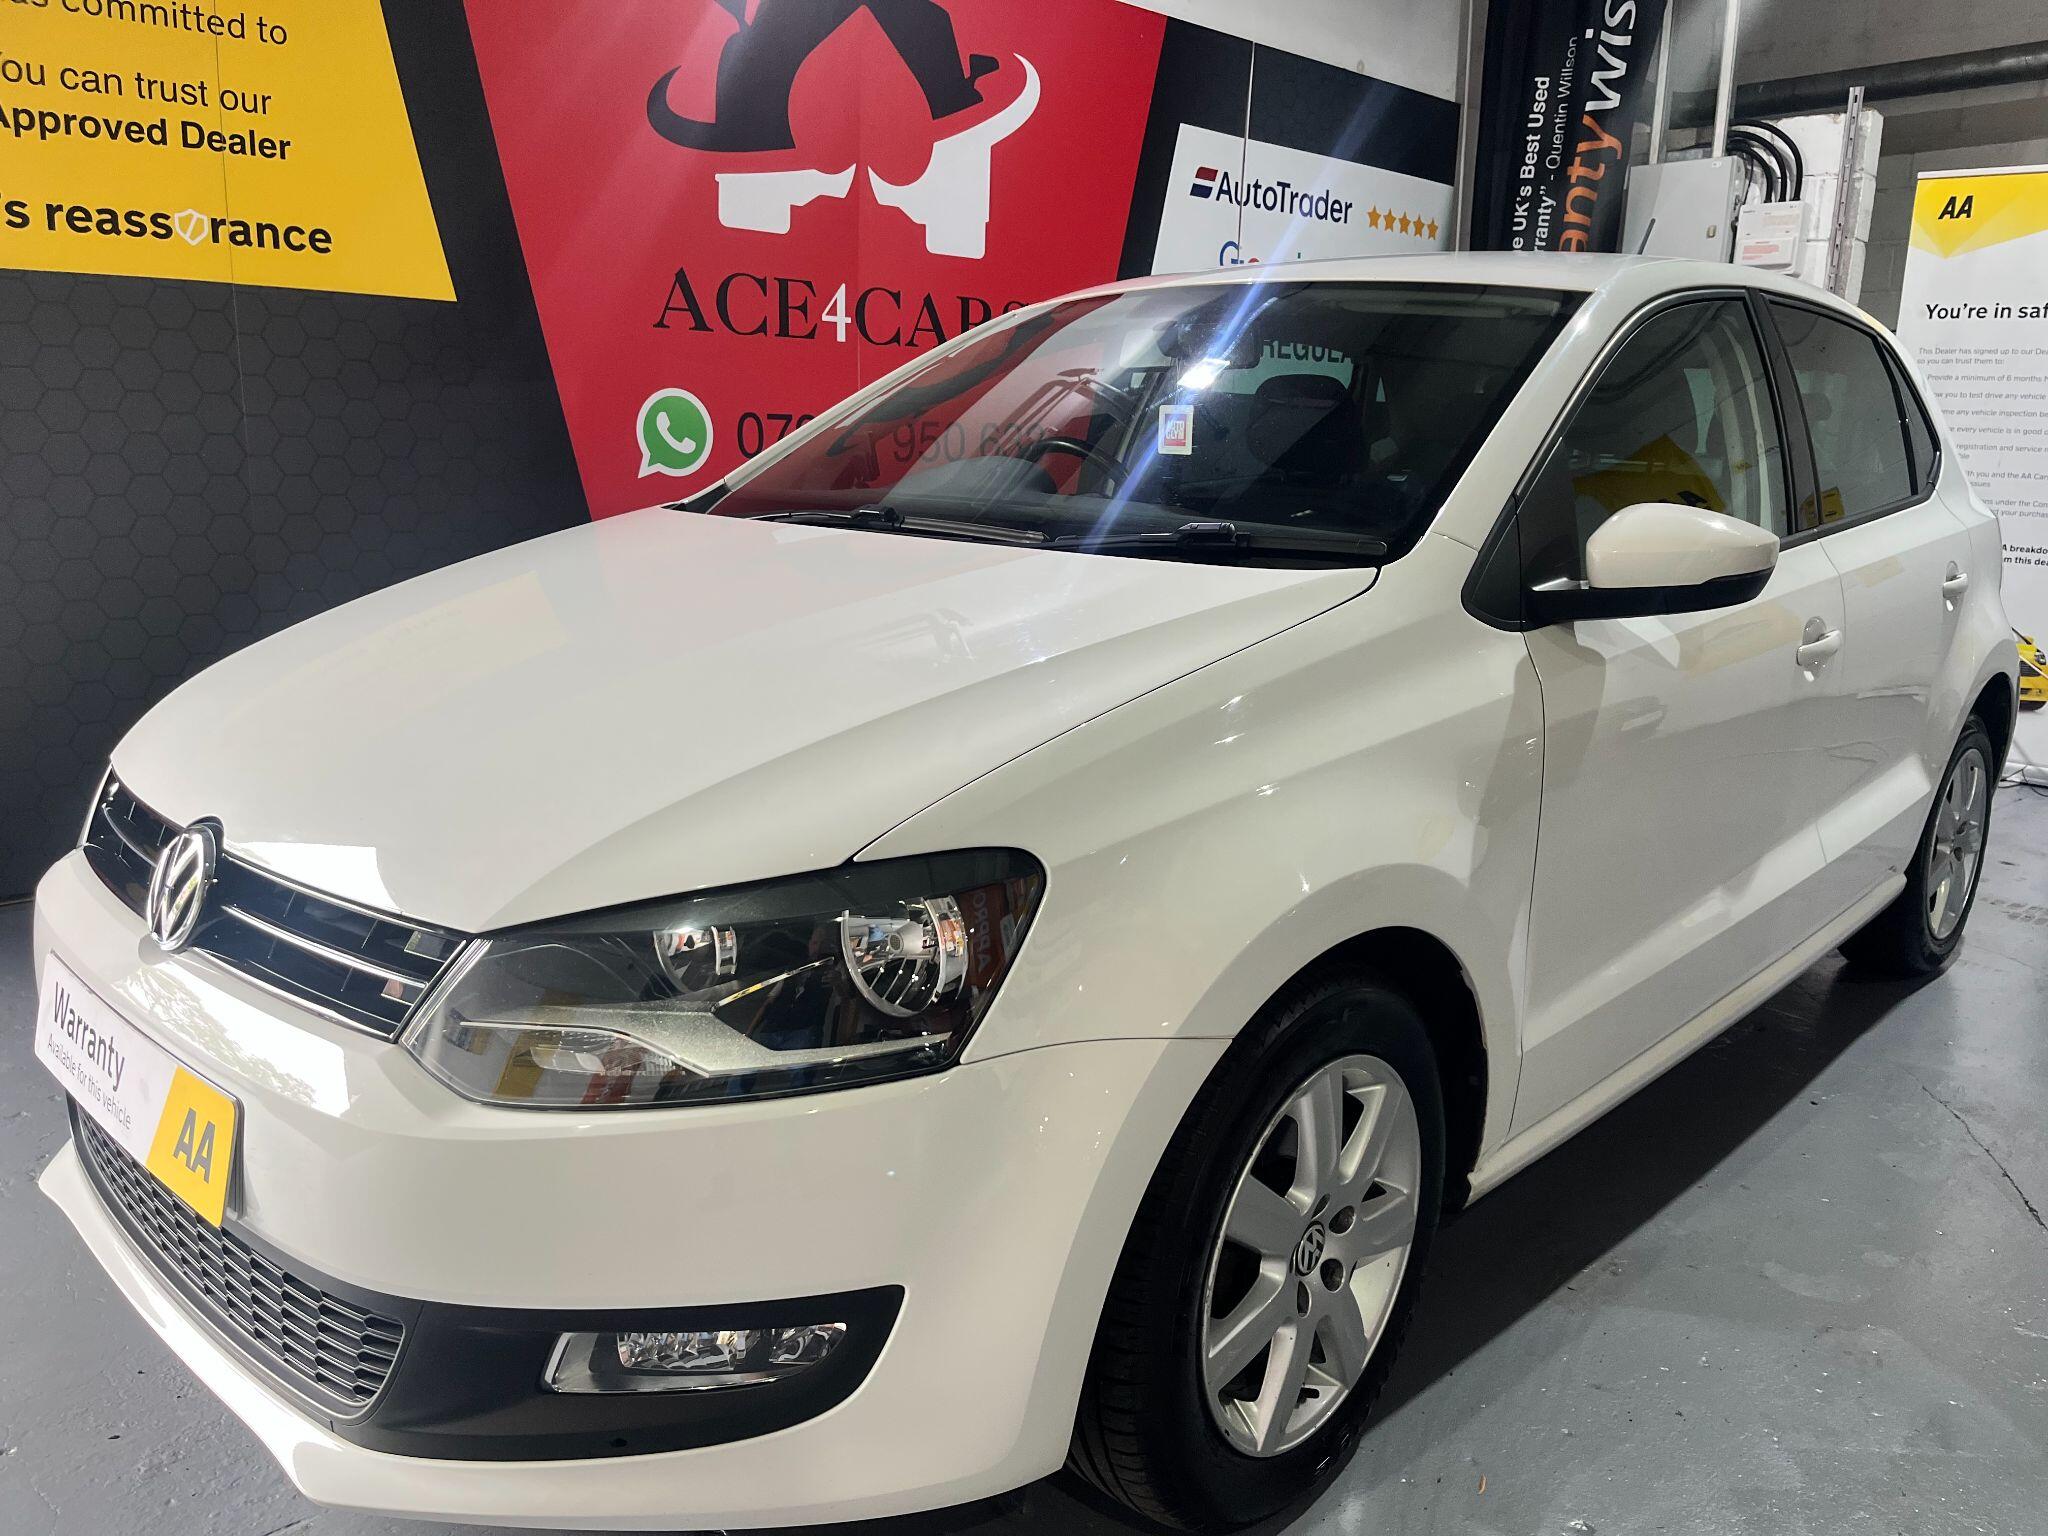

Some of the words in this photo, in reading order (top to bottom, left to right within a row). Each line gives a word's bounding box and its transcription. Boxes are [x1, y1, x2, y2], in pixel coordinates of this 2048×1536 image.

[62, 0, 245, 39] committed
[256, 16, 288, 45] to
[0, 51, 46, 86] ou
[60, 67, 123, 96] can
[134, 71, 208, 108] trust
[219, 88, 272, 115] our
[1527, 76, 1551, 129] Used
[1545, 102, 1568, 170] Quentin
[1557, 35, 1578, 99] Willson
[181, 120, 291, 161] Dealer
[1519, 134, 1541, 179] Best
[1215, 171, 1353, 224] AutoTrader
[1937, 195, 1974, 220] AA
[1994, 302, 2012, 319] in
[1927, 358, 1940, 366] you
[1955, 357, 1973, 365] trust
[1974, 357, 1994, 365] them
[1934, 347, 1957, 355] Dealer
[1959, 347, 1972, 355] has
[1973, 347, 1999, 357] signed
[1961, 374, 1996, 382] minimum
[2013, 375, 2042, 383] months
[1945, 392, 1958, 400] you
[1969, 391, 1983, 399] test
[1985, 391, 2003, 400] drive
[2004, 393, 2019, 401] any
[2020, 393, 2047, 401] vehicle
[1957, 426, 1978, 434] every
[1978, 425, 2004, 434] vehicle
[2022, 427, 2042, 436] good
[1971, 409, 1998, 417] vehicle
[1999, 409, 2038, 419] inspection
[737, 412, 814, 459] 07
[1991, 471, 2006, 479] and
[2008, 472, 2020, 480] the
[2018, 499, 2031, 507] the
[2014, 556, 2032, 565] this
[53, 981, 125, 1092] Warranty
[48, 1033, 77, 1077] Available
[77, 1062, 88, 1085] for
[88, 1073, 102, 1102] this
[102, 1090, 132, 1131] vehicle
[172, 1107, 216, 1184] AA
